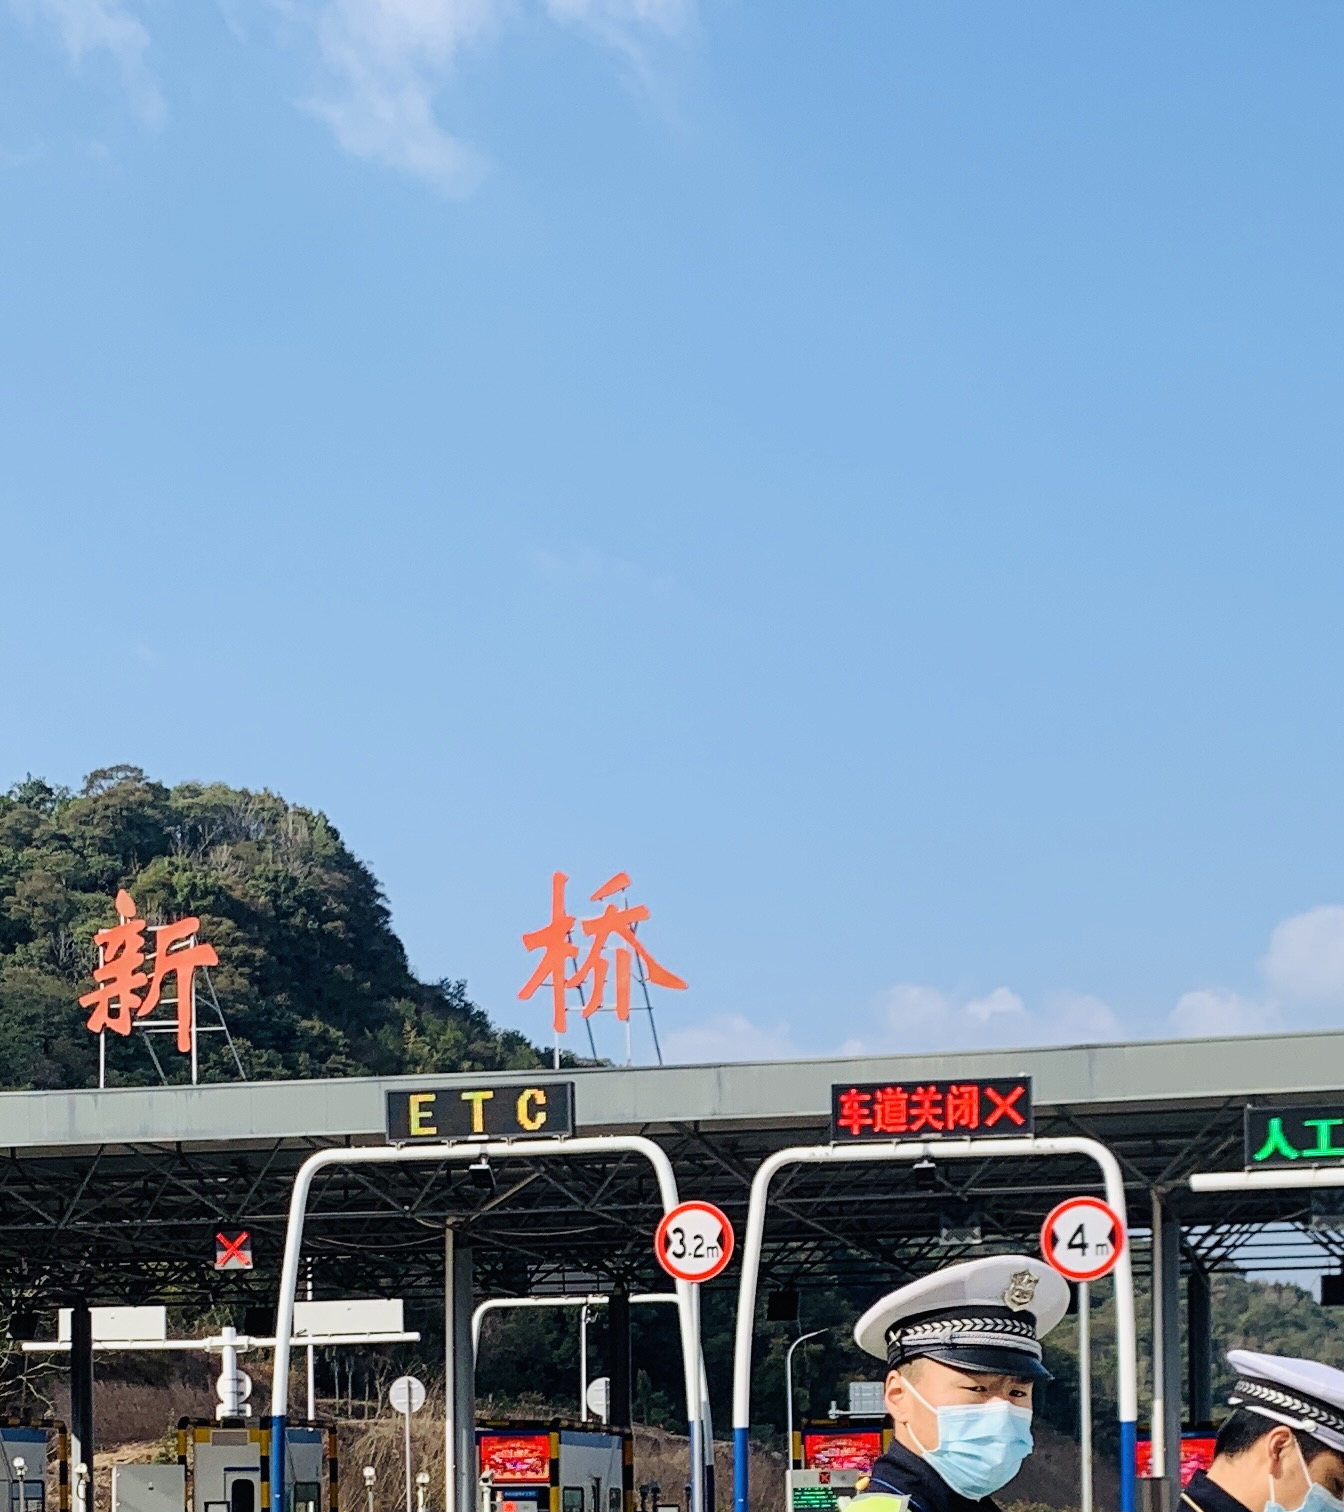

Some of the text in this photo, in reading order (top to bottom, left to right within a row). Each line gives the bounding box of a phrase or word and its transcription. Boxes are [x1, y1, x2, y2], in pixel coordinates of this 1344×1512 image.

[408, 1088, 548, 1136] ETC
[838, 1085, 981, 1134] 车道关闭
[671, 1226, 720, 1259] 3.2m
